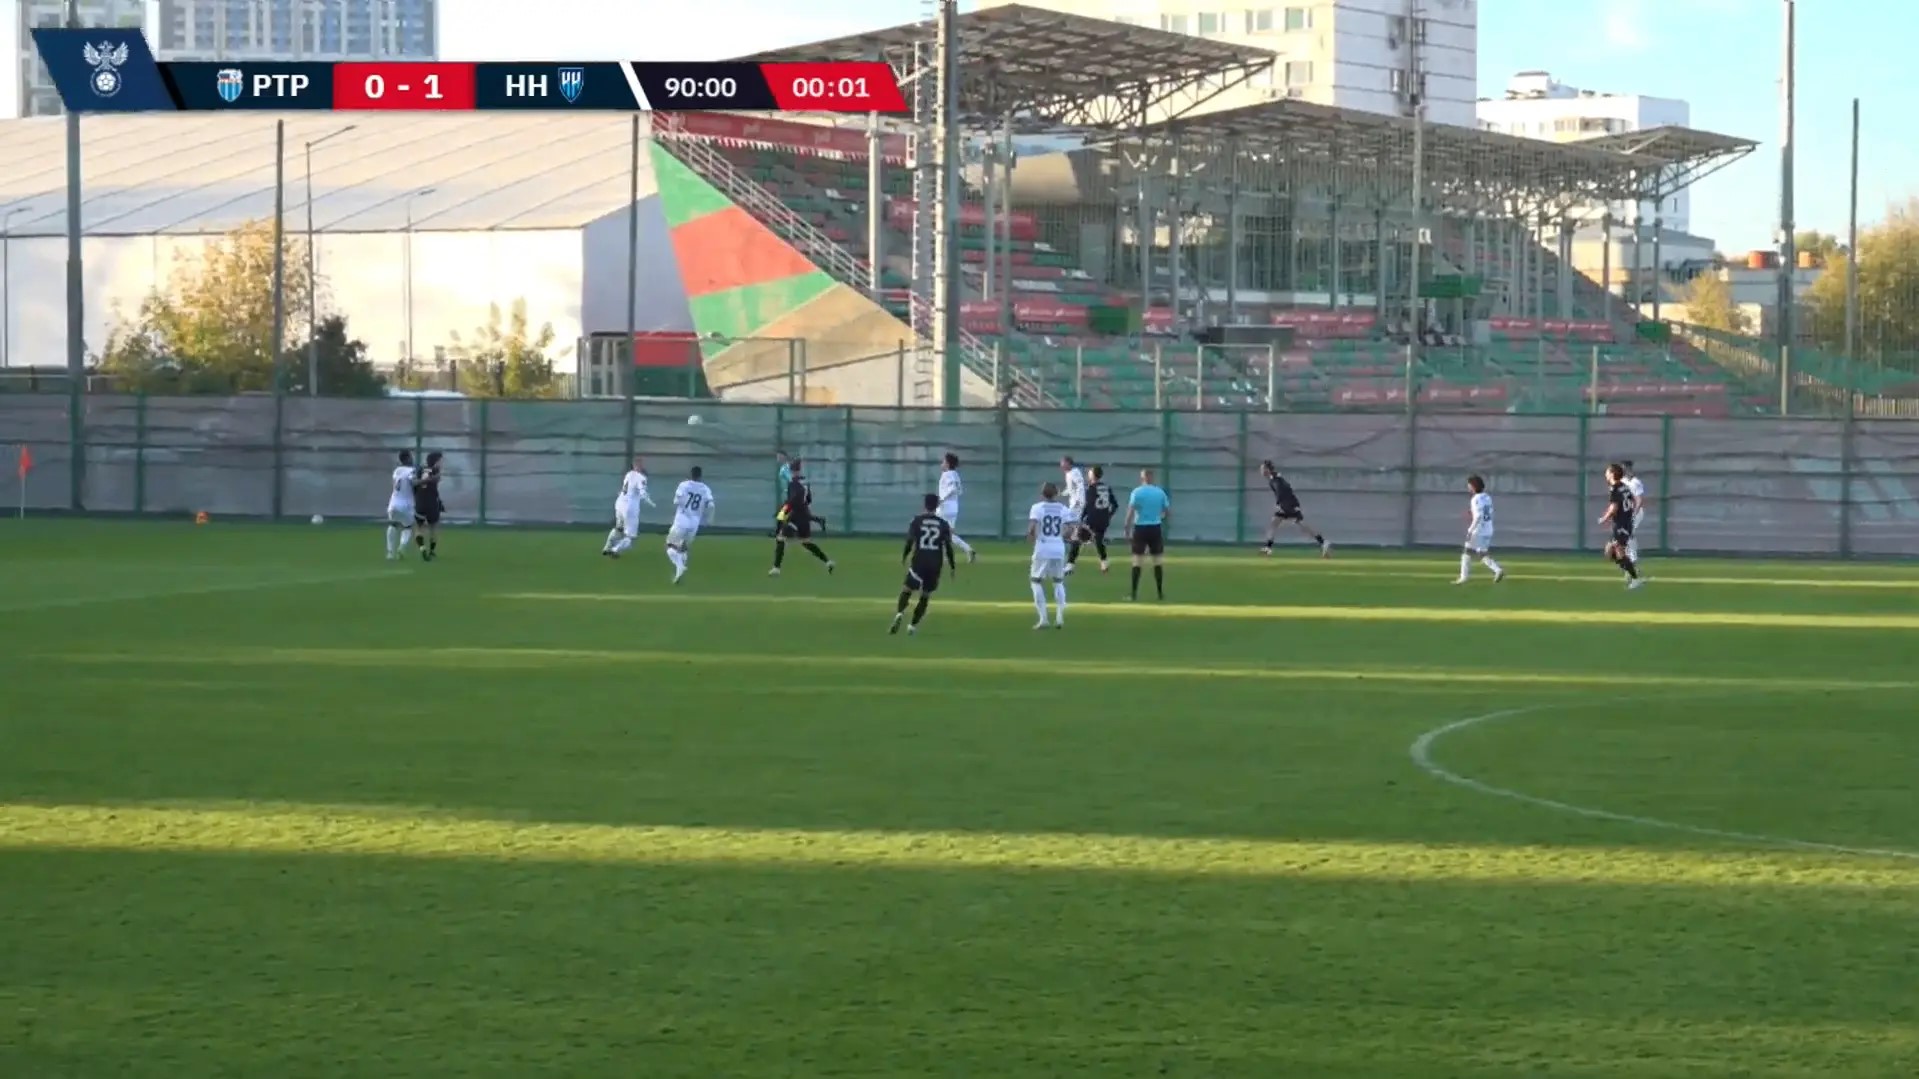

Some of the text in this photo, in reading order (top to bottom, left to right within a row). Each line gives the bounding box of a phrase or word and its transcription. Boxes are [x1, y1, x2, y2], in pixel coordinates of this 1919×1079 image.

[684, 492, 702, 511] 78
[1042, 515, 1061, 536] 83
[920, 526, 940, 549] 22
